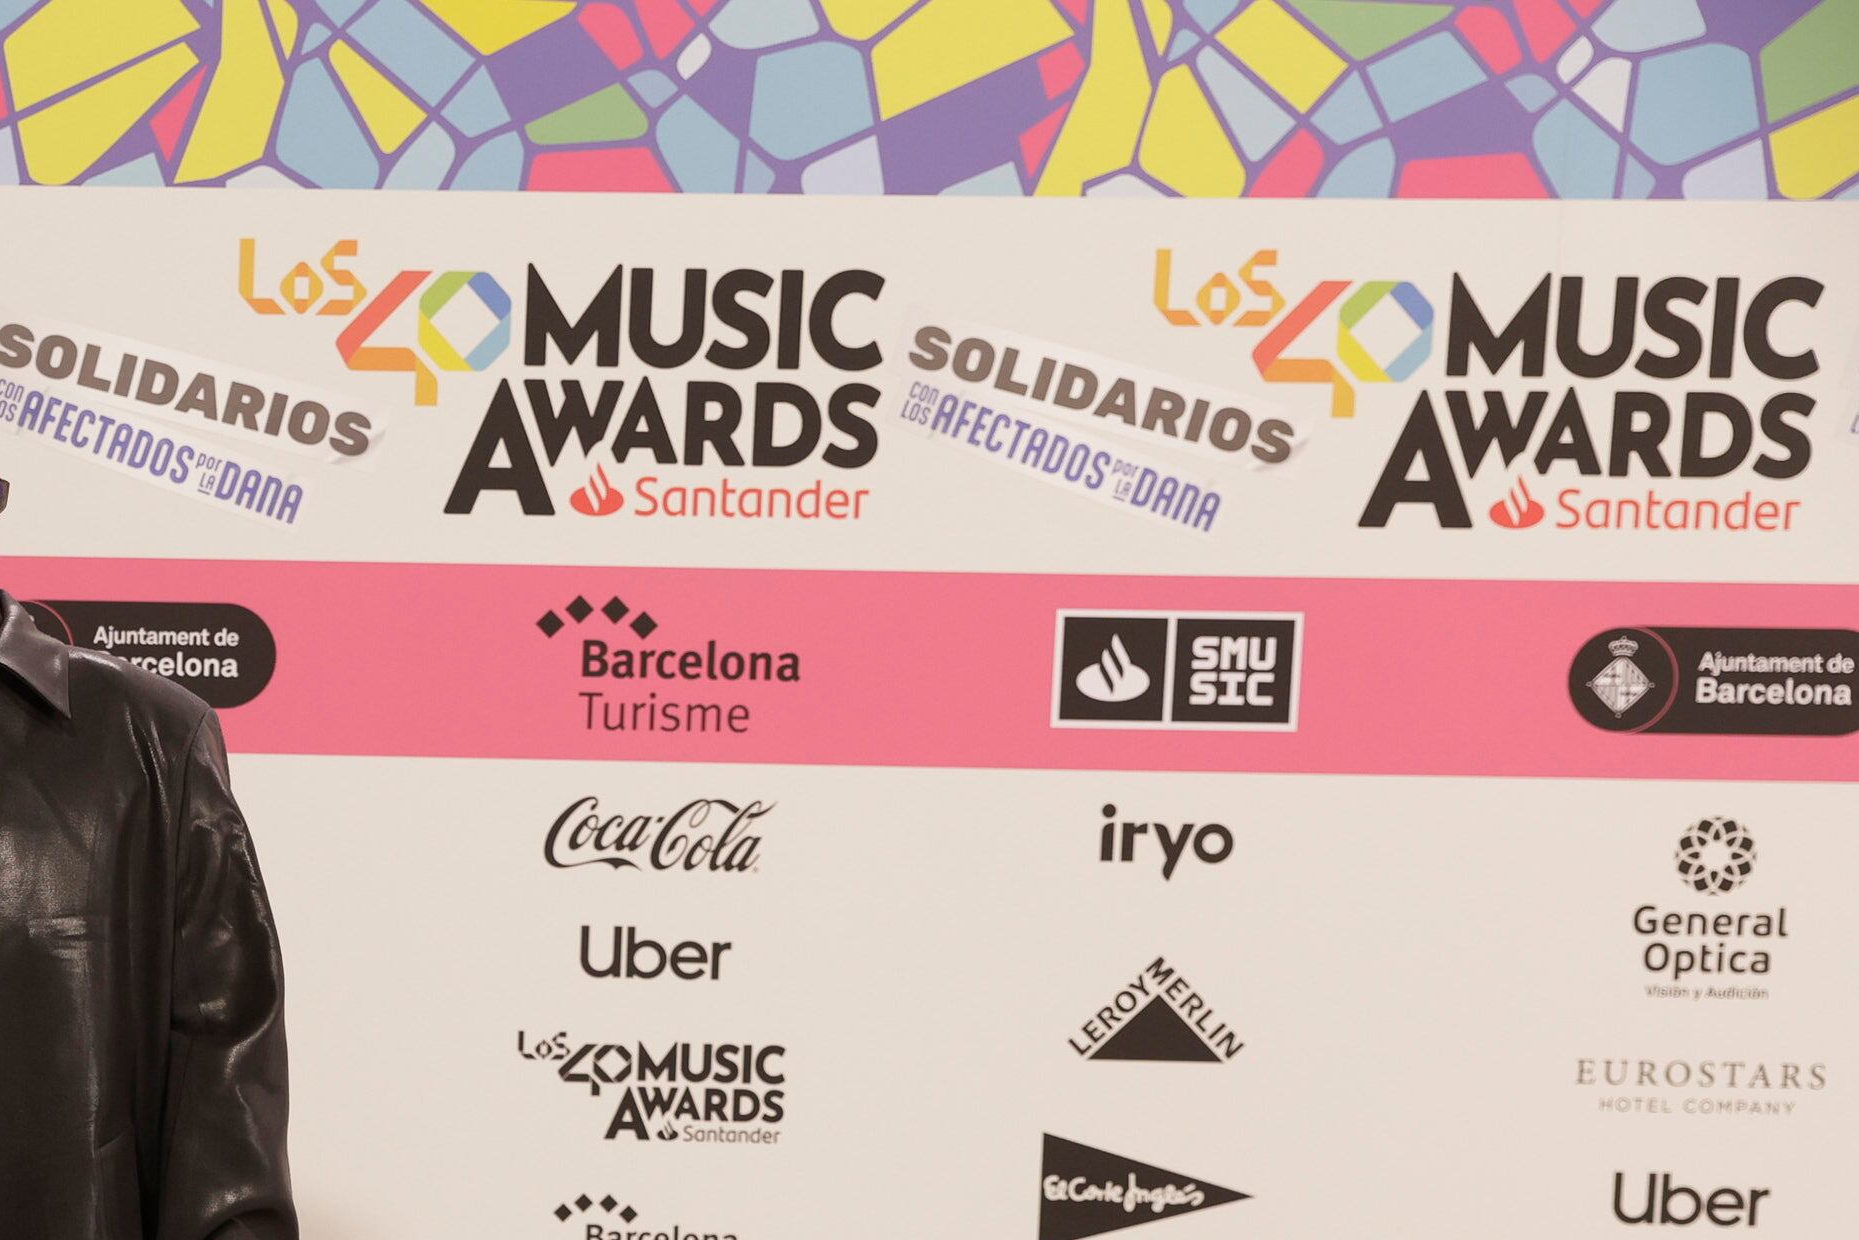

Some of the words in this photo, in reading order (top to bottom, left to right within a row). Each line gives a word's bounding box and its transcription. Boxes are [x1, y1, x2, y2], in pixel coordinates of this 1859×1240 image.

[336, 270, 512, 406] 40
[523, 262, 886, 371] MUSIC
[1251, 280, 1434, 418] 40
[1445, 271, 1826, 380] MUSIC
[908, 325, 1295, 465] SOLIDARIOS
[17, 390, 194, 484] AFECTADOS
[214, 459, 304, 525] DANA
[443, 375, 882, 516] AWARDS
[931, 394, 1111, 490] AFECTADOS
[1129, 468, 1222, 532] DANA
[1357, 386, 1818, 529] AWARDS
[633, 476, 870, 520] Santander
[1554, 488, 1802, 532] Santander
[93, 625, 209, 649] Ajuntament
[213, 627, 240, 647] de
[98, 650, 239, 678] rcelona
[581, 639, 801, 682] Barcelona
[1697, 651, 1824, 677] Ajuntament
[1826, 653, 1855, 674] de
[579, 692, 751, 734] Turisme
[1695, 676, 1852, 706] Barcelona
[544, 796, 780, 873] Coca-Cola
[1100, 803, 1234, 882] iryo
[1633, 905, 1788, 937] General
[580, 924, 732, 981] Uber
[1644, 943, 1771, 981] Optica
[1067, 974, 1151, 1057] LEROY
[1145, 956, 1245, 1060] MERLIN
[557, 1043, 633, 1096] 40
[637, 1041, 787, 1085] MUSIC
[1575, 1058, 1827, 1090] EUROSTARS
[603, 1086, 786, 1141] AWARDS
[1598, 1097, 1673, 1113] HOTEL
[1683, 1098, 1796, 1115] COMPANY
[682, 1125, 781, 1145] Santander
[1613, 1172, 1770, 1227] Uber
